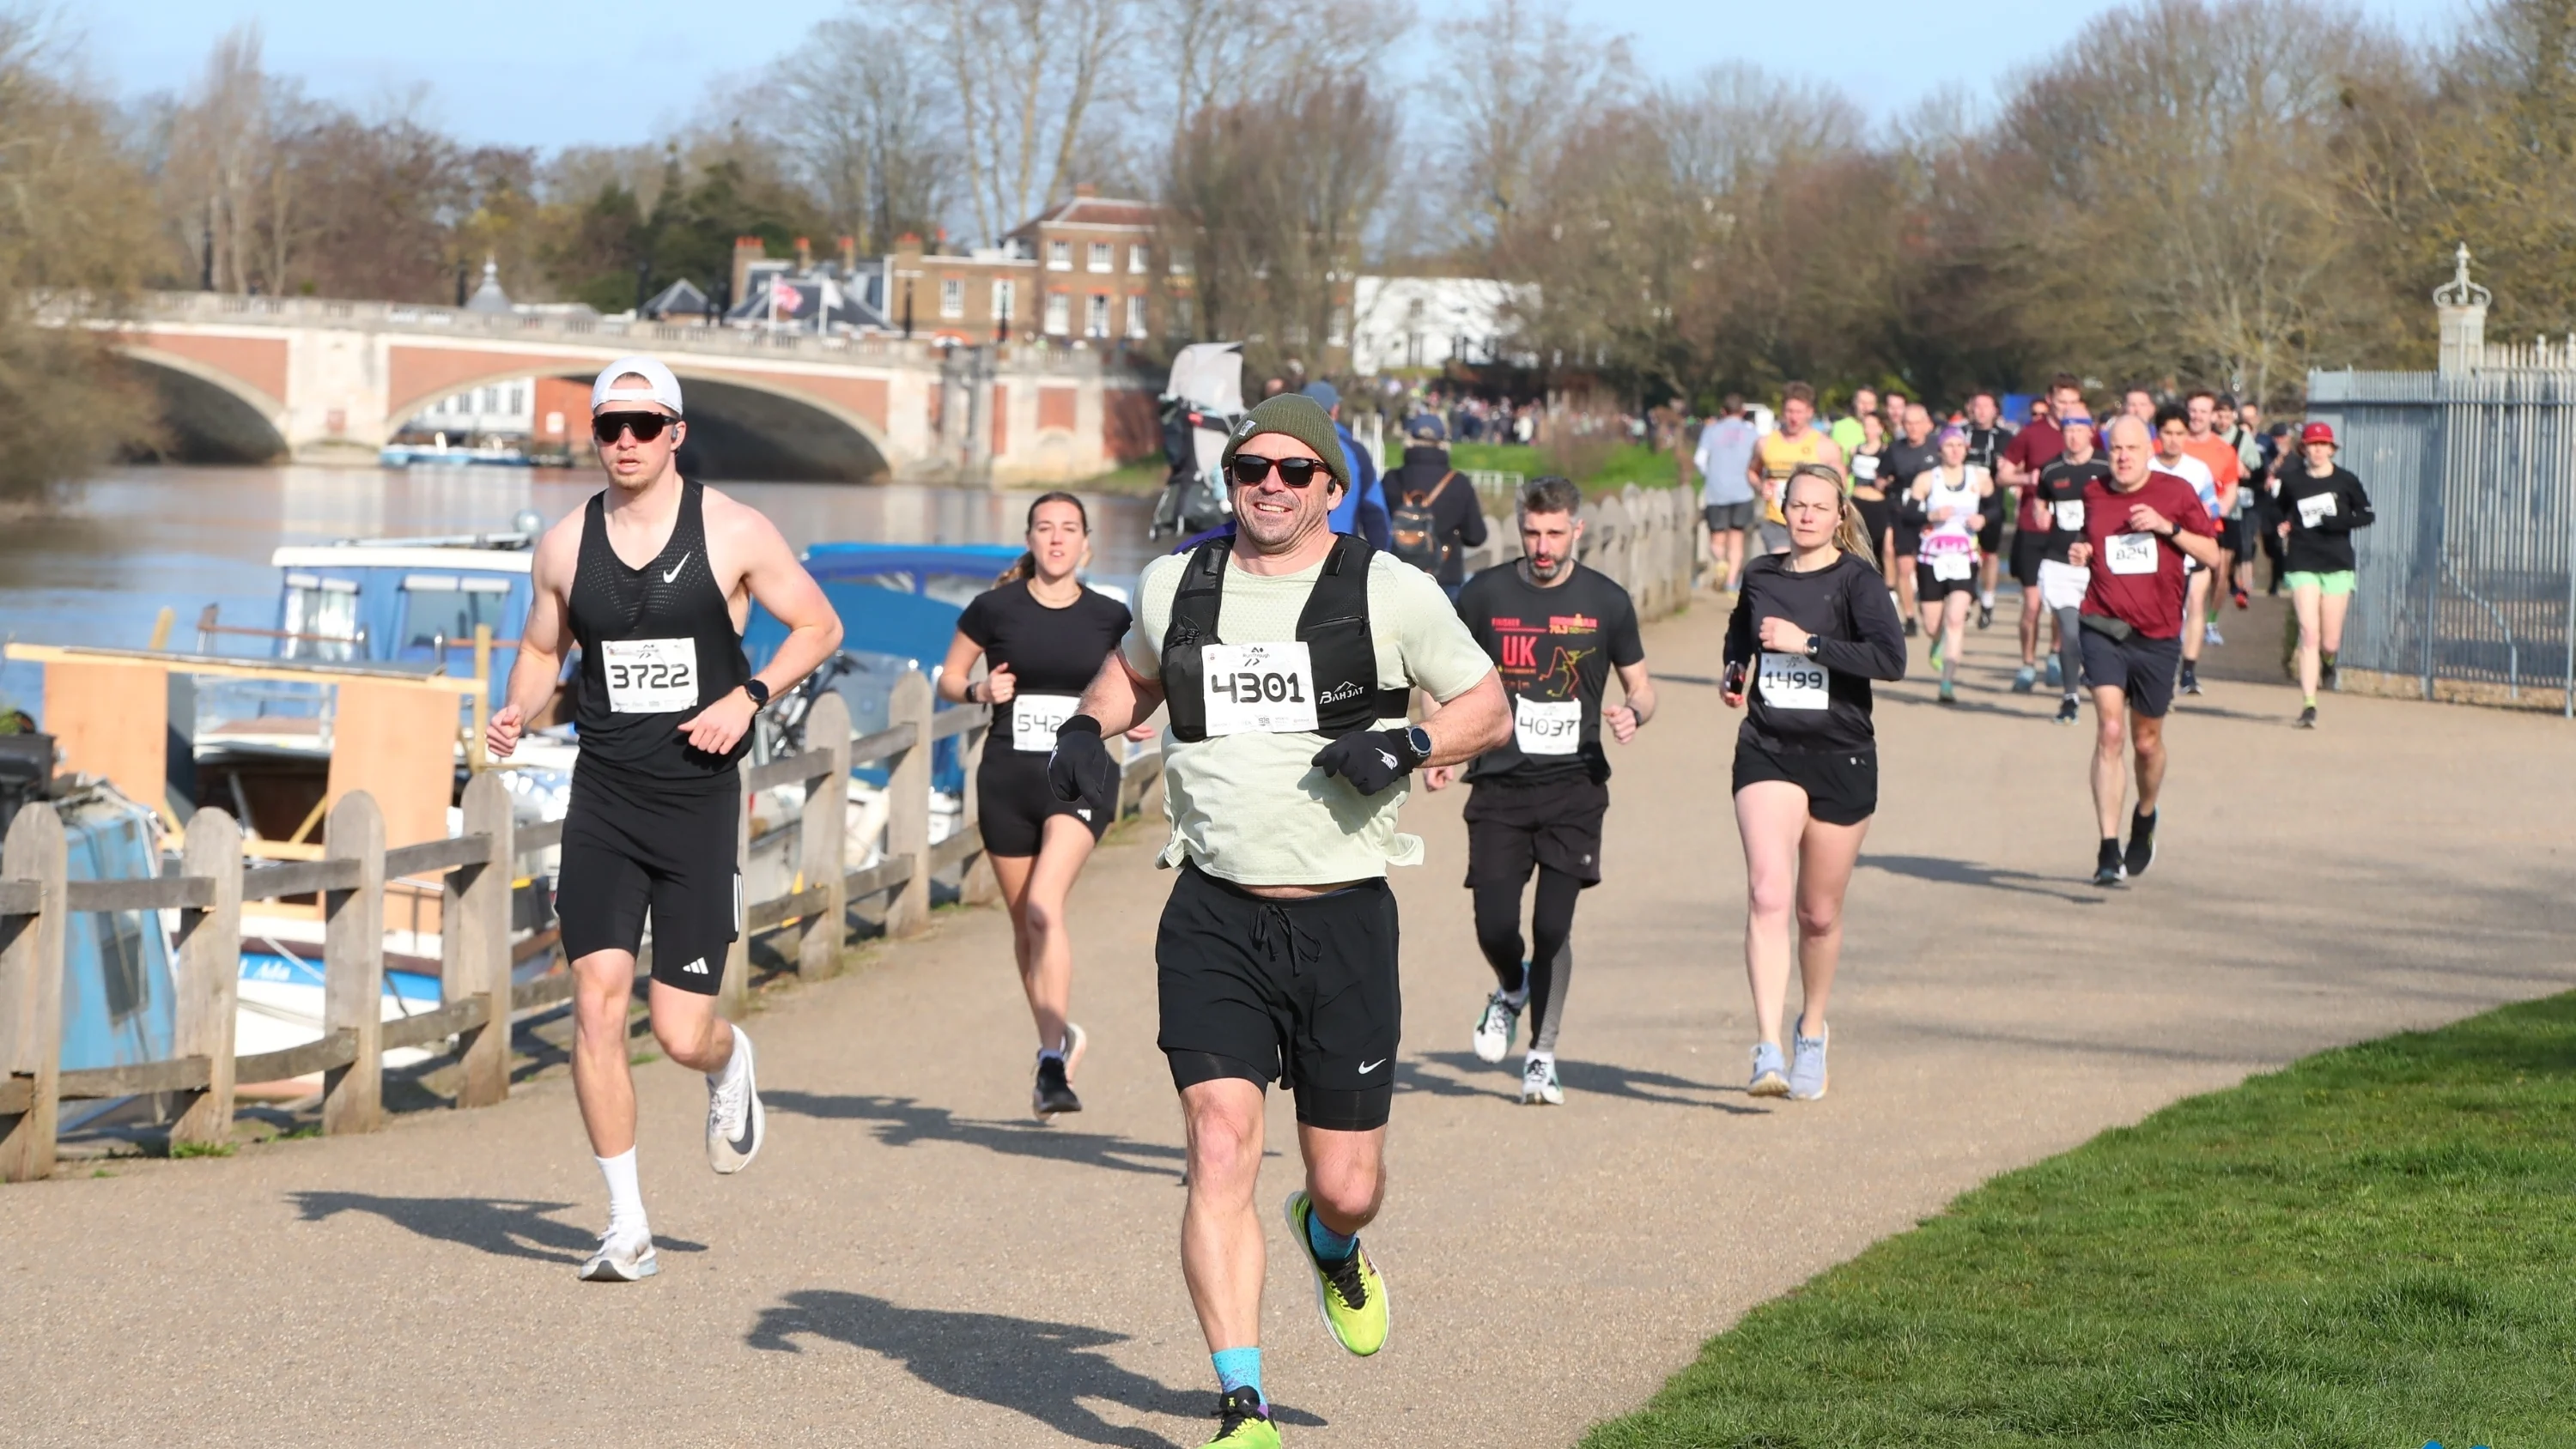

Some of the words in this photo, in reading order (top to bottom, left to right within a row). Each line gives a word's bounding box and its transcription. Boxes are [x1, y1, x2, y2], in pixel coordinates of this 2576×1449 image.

[1503, 635, 1538, 666] UK
[610, 664, 690, 688] 3722
[1765, 670, 1823, 689] 1499
[1211, 672, 1305, 704] 4301
[1018, 714, 1068, 733] 542
[1519, 716, 1577, 737] 4037
